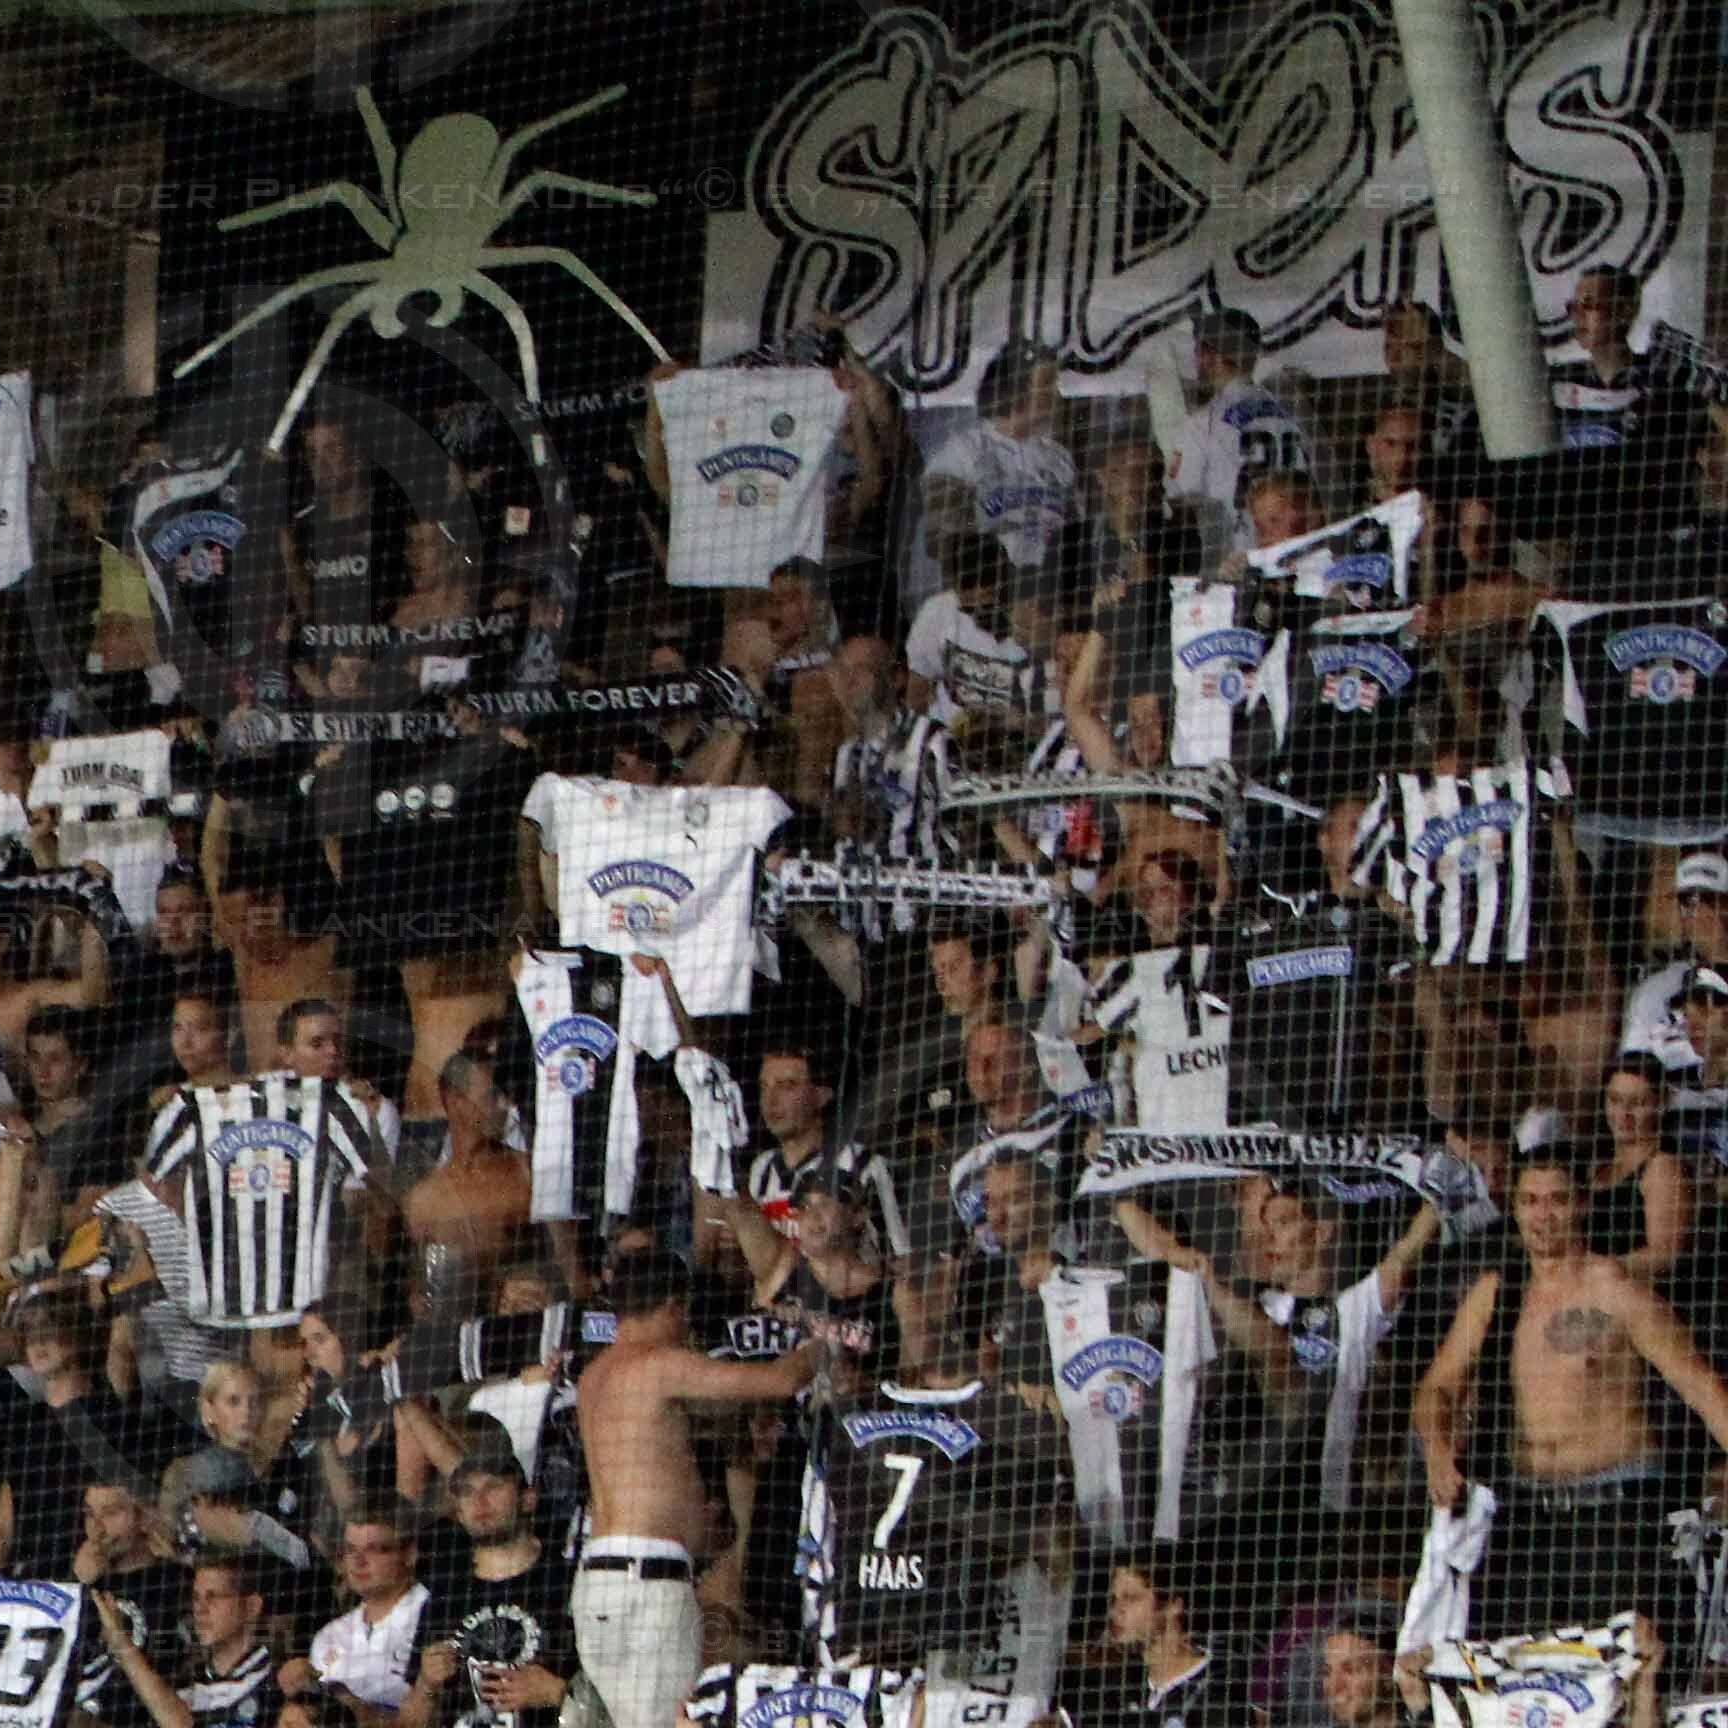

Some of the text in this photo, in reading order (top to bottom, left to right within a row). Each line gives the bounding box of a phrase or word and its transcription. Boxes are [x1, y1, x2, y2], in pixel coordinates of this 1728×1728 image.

[1606, 625, 1725, 678] PUNTIGAMER
[567, 681, 701, 712] FOREVER
[589, 861, 694, 900] PUNTIGAMER
[1248, 949, 1352, 986] PUNTIGAMER
[209, 1122, 315, 1166] PUNTIGAMER
[1059, 1336, 1163, 1390] PUNTIGAMER
[873, 1453, 923, 1549] 7
[858, 1553, 924, 1592] HAAS
